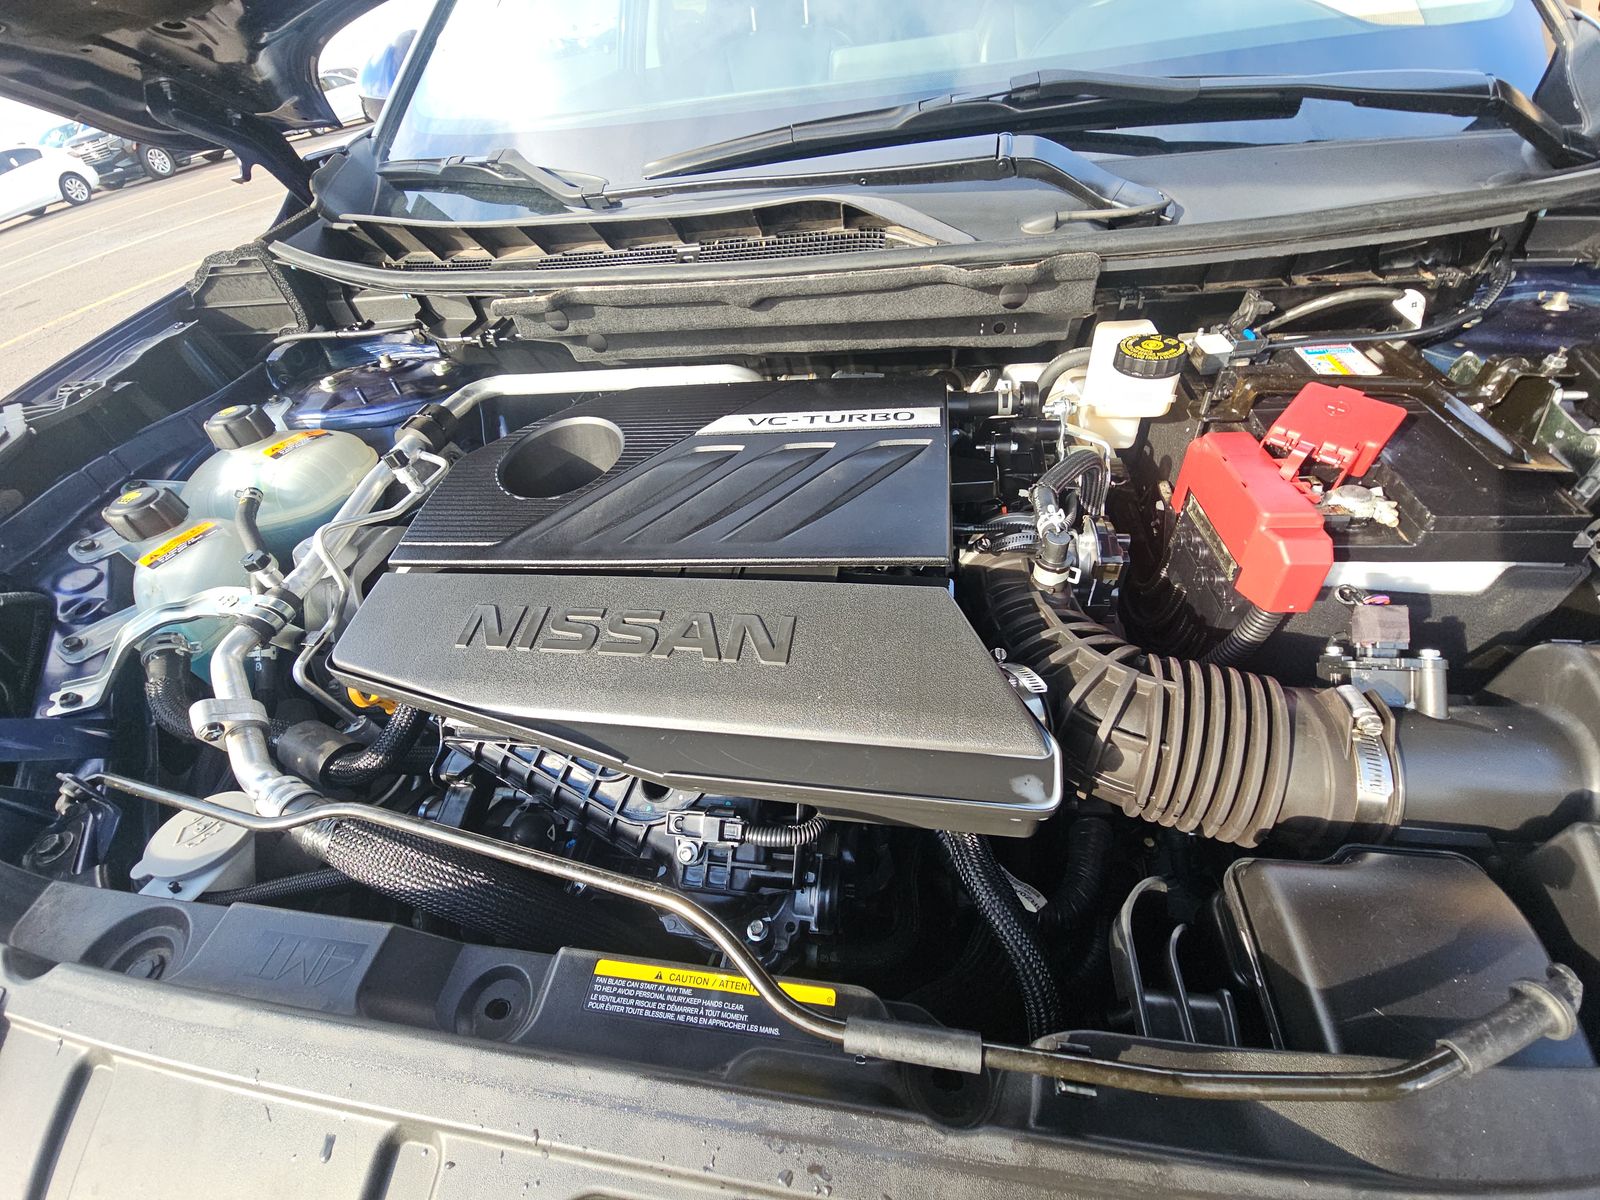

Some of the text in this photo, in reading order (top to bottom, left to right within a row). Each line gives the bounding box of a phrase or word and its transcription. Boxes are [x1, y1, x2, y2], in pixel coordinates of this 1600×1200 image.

[455, 604, 797, 665] NISSAN
[608, 978, 626, 986] BLADE
[640, 982, 658, 991] START
[670, 973, 709, 985] CAUTION
[598, 994, 634, 1004] VENTILATEUR
[635, 1000, 657, 1008] RISQUE
[667, 1003, 700, 1014] DÉMARRER
[721, 1012, 748, 1022] MOMENT.
[617, 988, 635, 996] AVOID
[635, 990, 665, 1000] PERSONAL
[702, 1000, 722, 1008] HANDS
[724, 1002, 744, 1012] CLEAR.
[588, 1002, 604, 1010] POUR
[605, 1002, 624, 1013] ÉVITER
[625, 1007, 644, 1015] TOUTE
[644, 1010, 676, 1020] BLESSURE,
[708, 1019, 746, 1030] APPROCHER
[746, 1024, 759, 1032] LES
[759, 1026, 780, 1036] MAINS.
